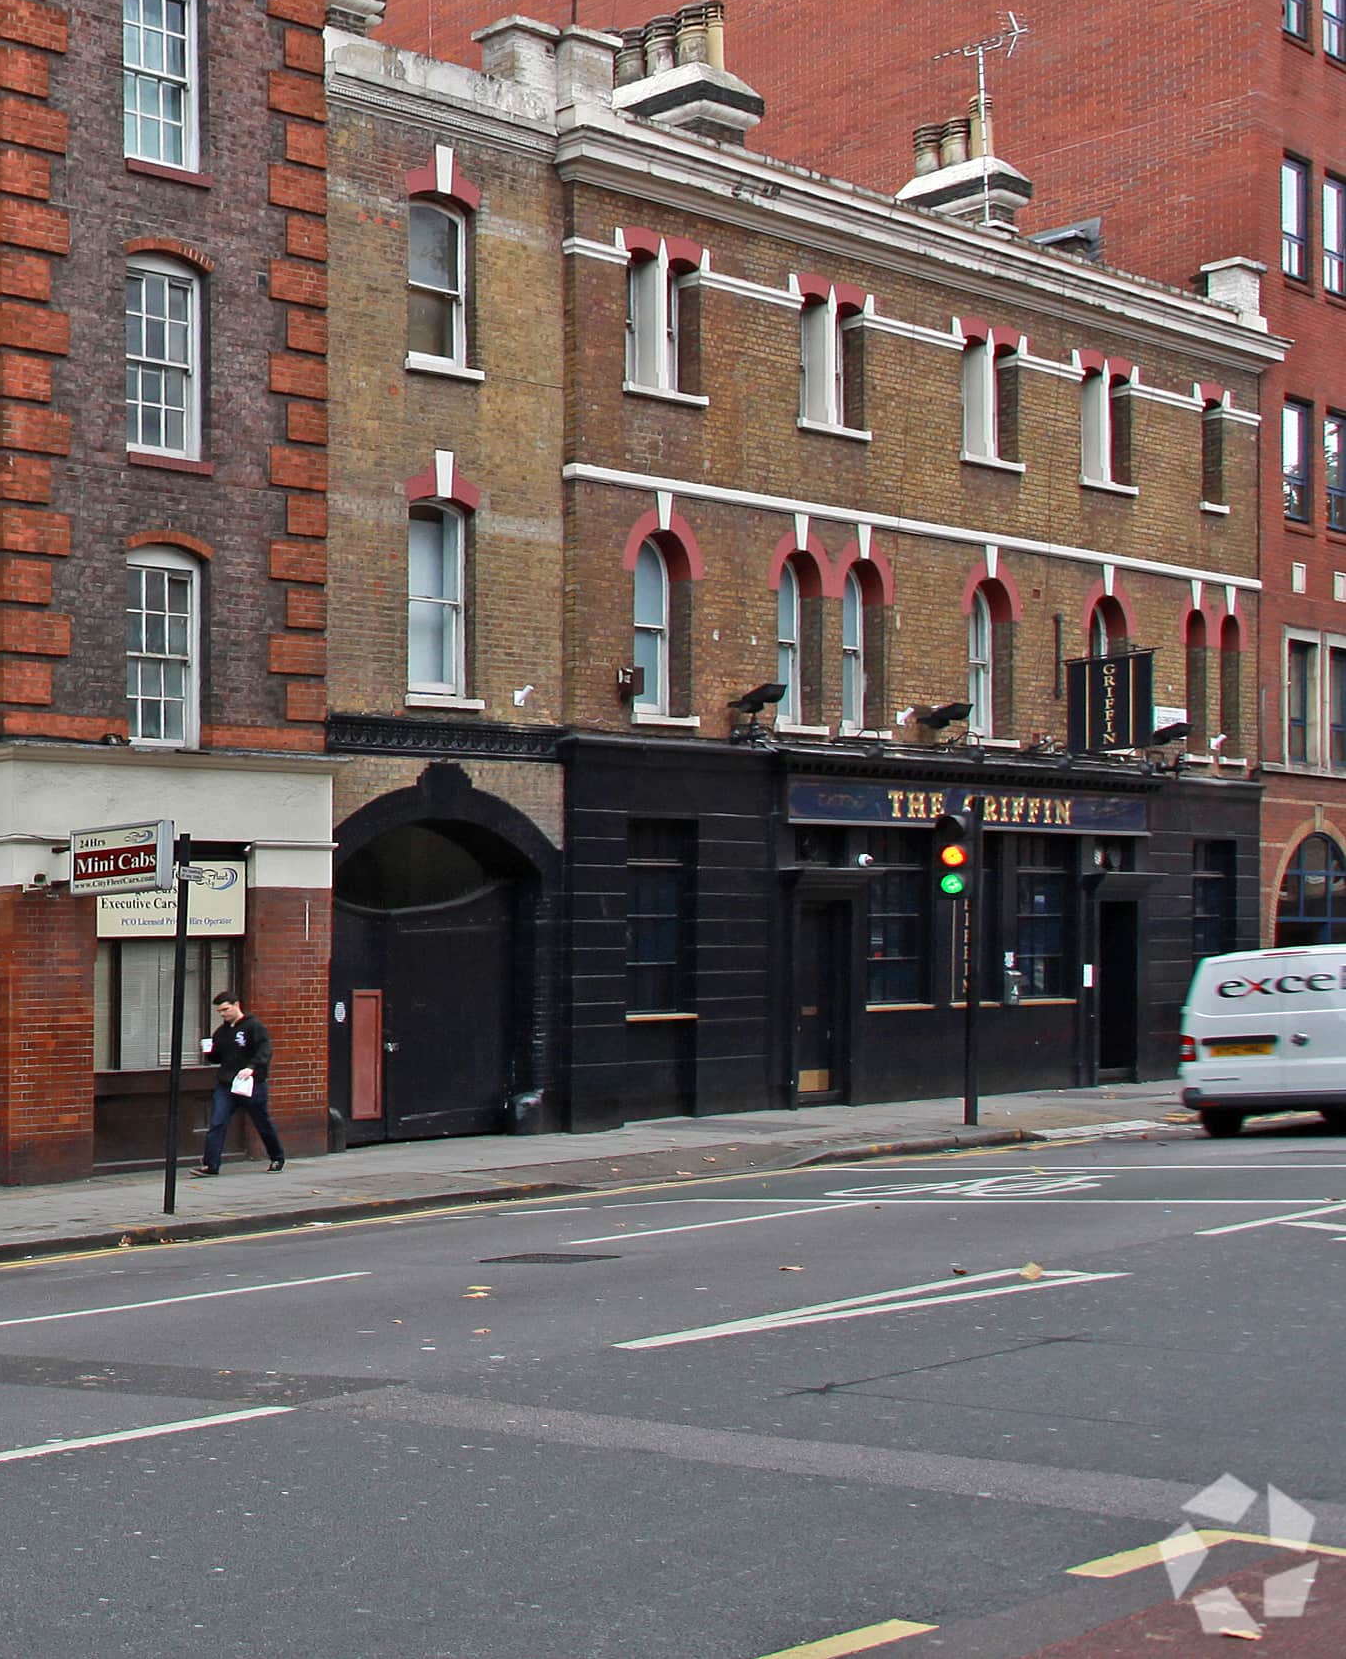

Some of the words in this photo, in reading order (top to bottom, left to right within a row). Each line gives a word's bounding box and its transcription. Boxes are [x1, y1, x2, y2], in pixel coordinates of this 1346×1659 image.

[1103, 664, 1115, 744] GRIFFIN
[887, 790, 945, 819] THE
[76, 854, 115, 875] Mini
[118, 851, 156, 870] Cabs
[101, 897, 151, 909] Executive
[153, 897, 178, 909] Cars
[204, 917, 232, 927] Operator
